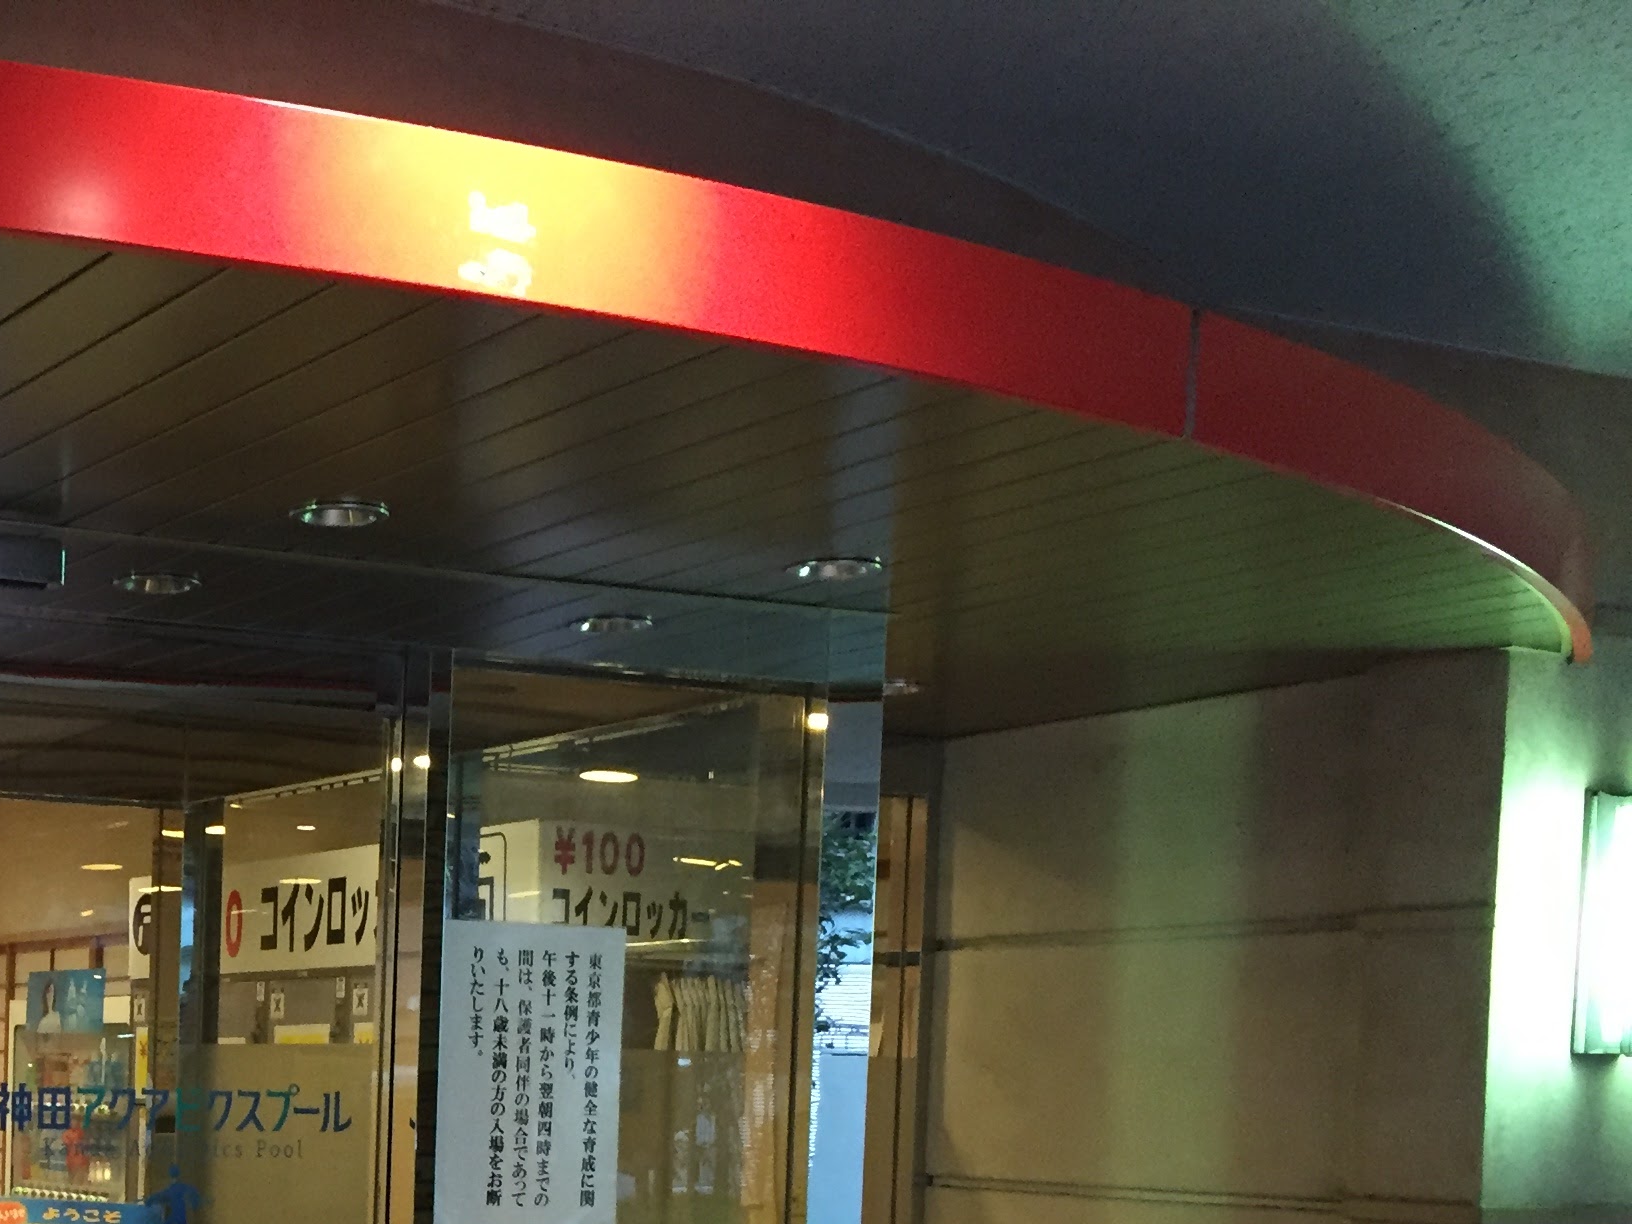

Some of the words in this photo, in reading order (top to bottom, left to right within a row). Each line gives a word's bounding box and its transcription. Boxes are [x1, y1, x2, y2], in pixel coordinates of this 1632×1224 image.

[260, 877, 378, 952] コインロッ
[42, 1207, 122, 1223] ようこそ
